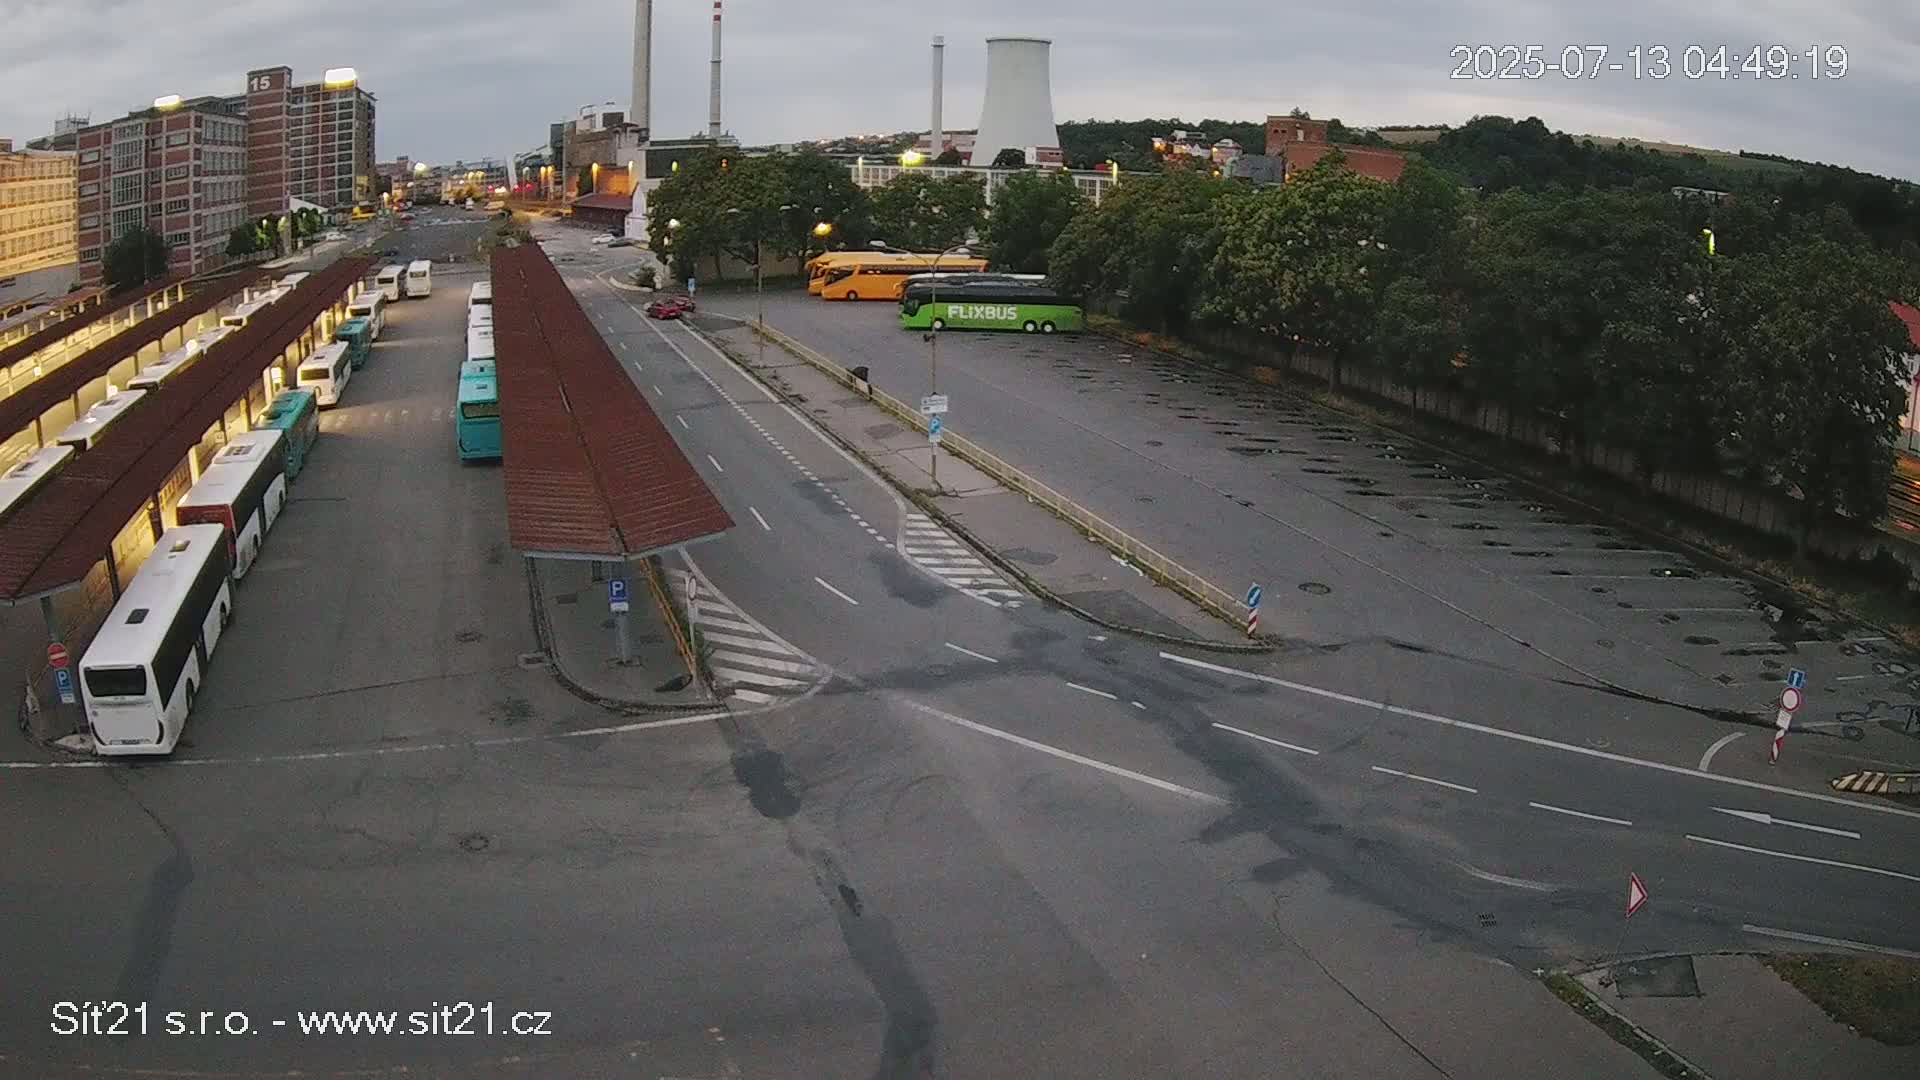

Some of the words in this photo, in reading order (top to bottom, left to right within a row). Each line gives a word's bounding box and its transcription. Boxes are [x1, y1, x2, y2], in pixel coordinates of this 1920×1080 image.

[250, 75, 271, 91] 15
[612, 581, 624, 596] P
[58, 671, 67, 685] P
